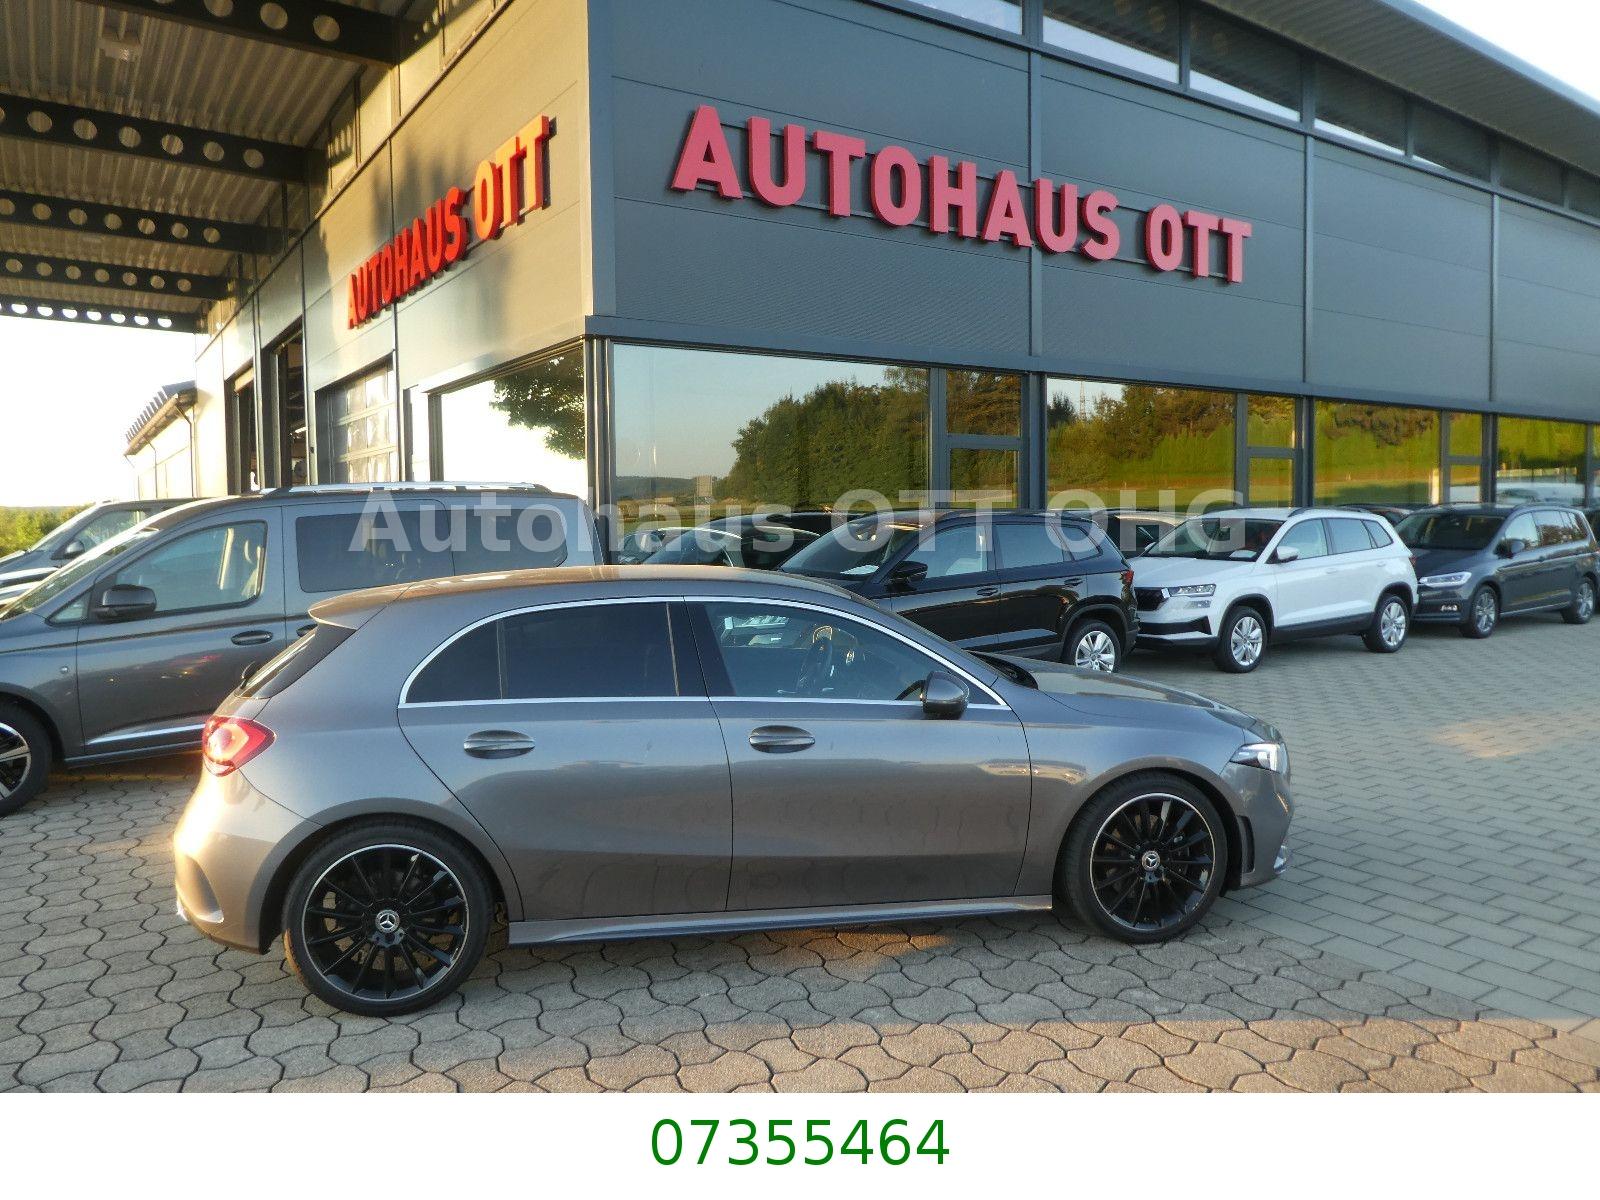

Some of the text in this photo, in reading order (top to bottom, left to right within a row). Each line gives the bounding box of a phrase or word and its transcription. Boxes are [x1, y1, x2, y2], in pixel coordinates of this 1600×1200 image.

[347, 114, 552, 330] AUTOHAUS OTT
[671, 104, 1253, 284] AUTOHAUS OTT
